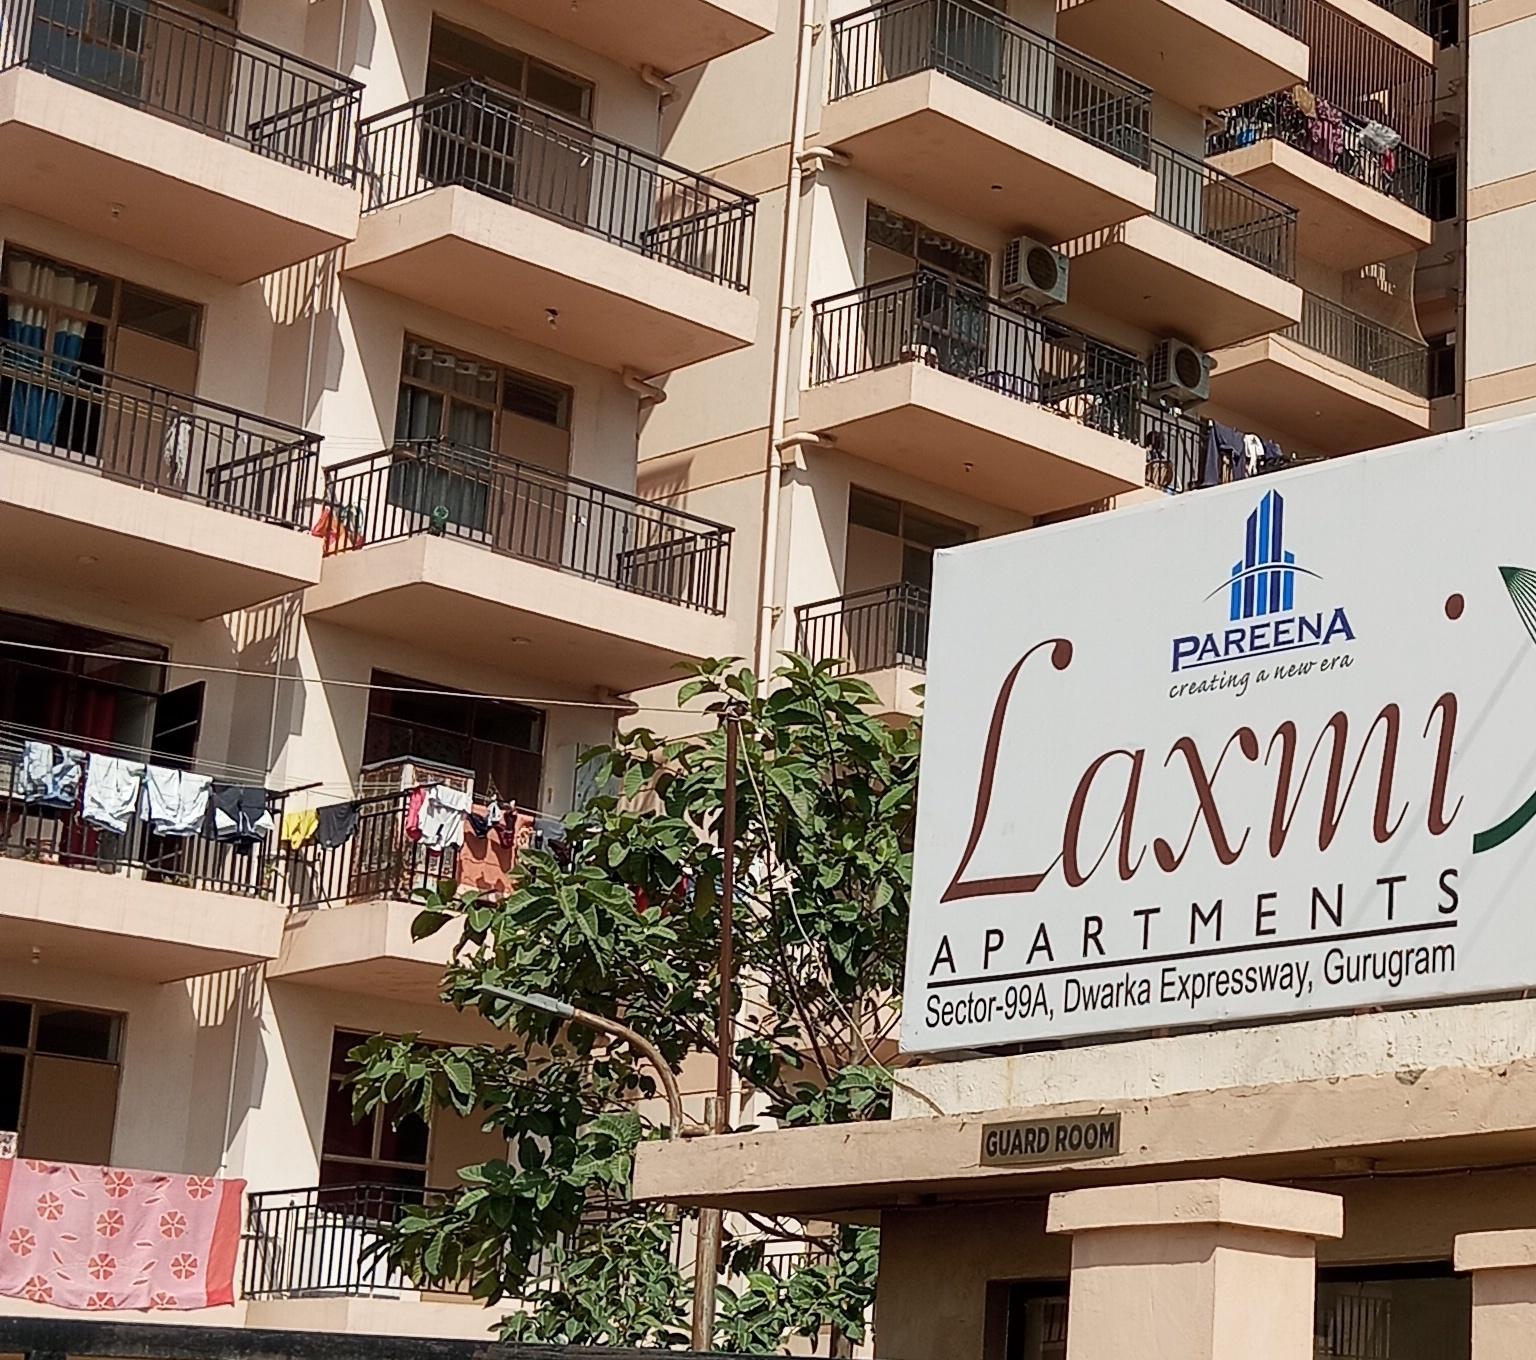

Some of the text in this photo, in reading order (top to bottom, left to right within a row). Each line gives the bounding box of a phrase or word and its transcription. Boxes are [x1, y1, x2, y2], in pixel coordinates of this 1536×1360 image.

[1169, 654, 1354, 698] creating a new era
[1171, 607, 1356, 672] PAREENA
[939, 592, 1464, 904] Laxmi
[929, 868, 1459, 976] APARTMENTS
[925, 943, 1455, 1028] Sector-99A, Dwarka Expressway, Gurugram
[986, 1122, 1115, 1157] GUARD ROOM
